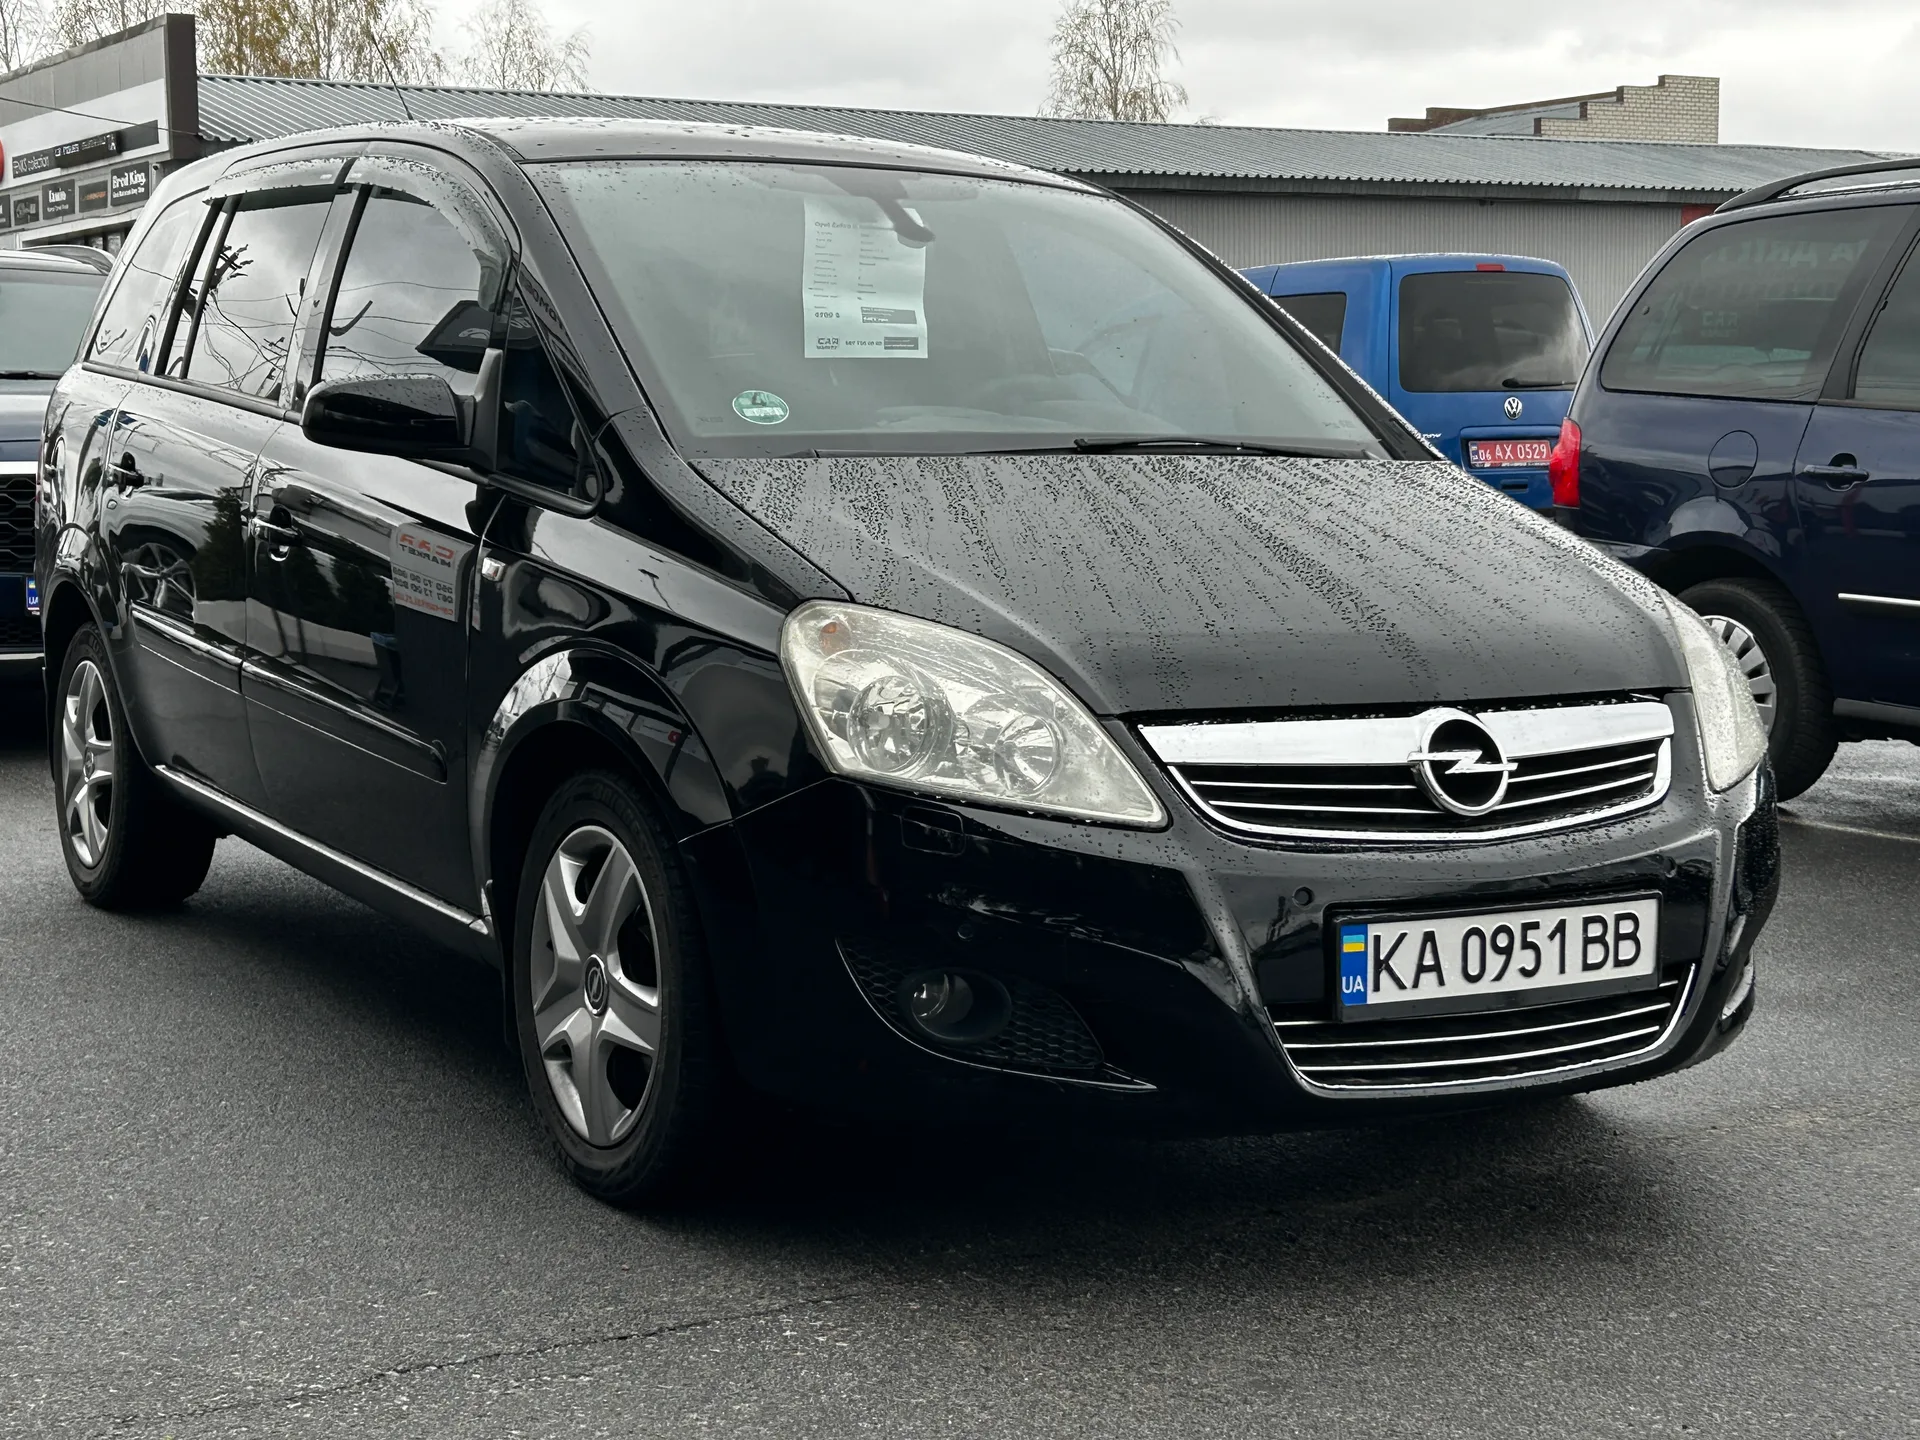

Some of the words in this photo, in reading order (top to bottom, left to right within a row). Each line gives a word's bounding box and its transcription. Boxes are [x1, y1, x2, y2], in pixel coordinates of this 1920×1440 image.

[130, 169, 147, 187] King
[1479, 449, 1492, 461] 06
[1495, 444, 1514, 460] AX
[1517, 443, 1547, 460] 0529
[1342, 975, 1365, 994] UA
[1372, 930, 1446, 993] KA
[1461, 917, 1567, 984] 0951
[1581, 911, 1642, 972] BB
